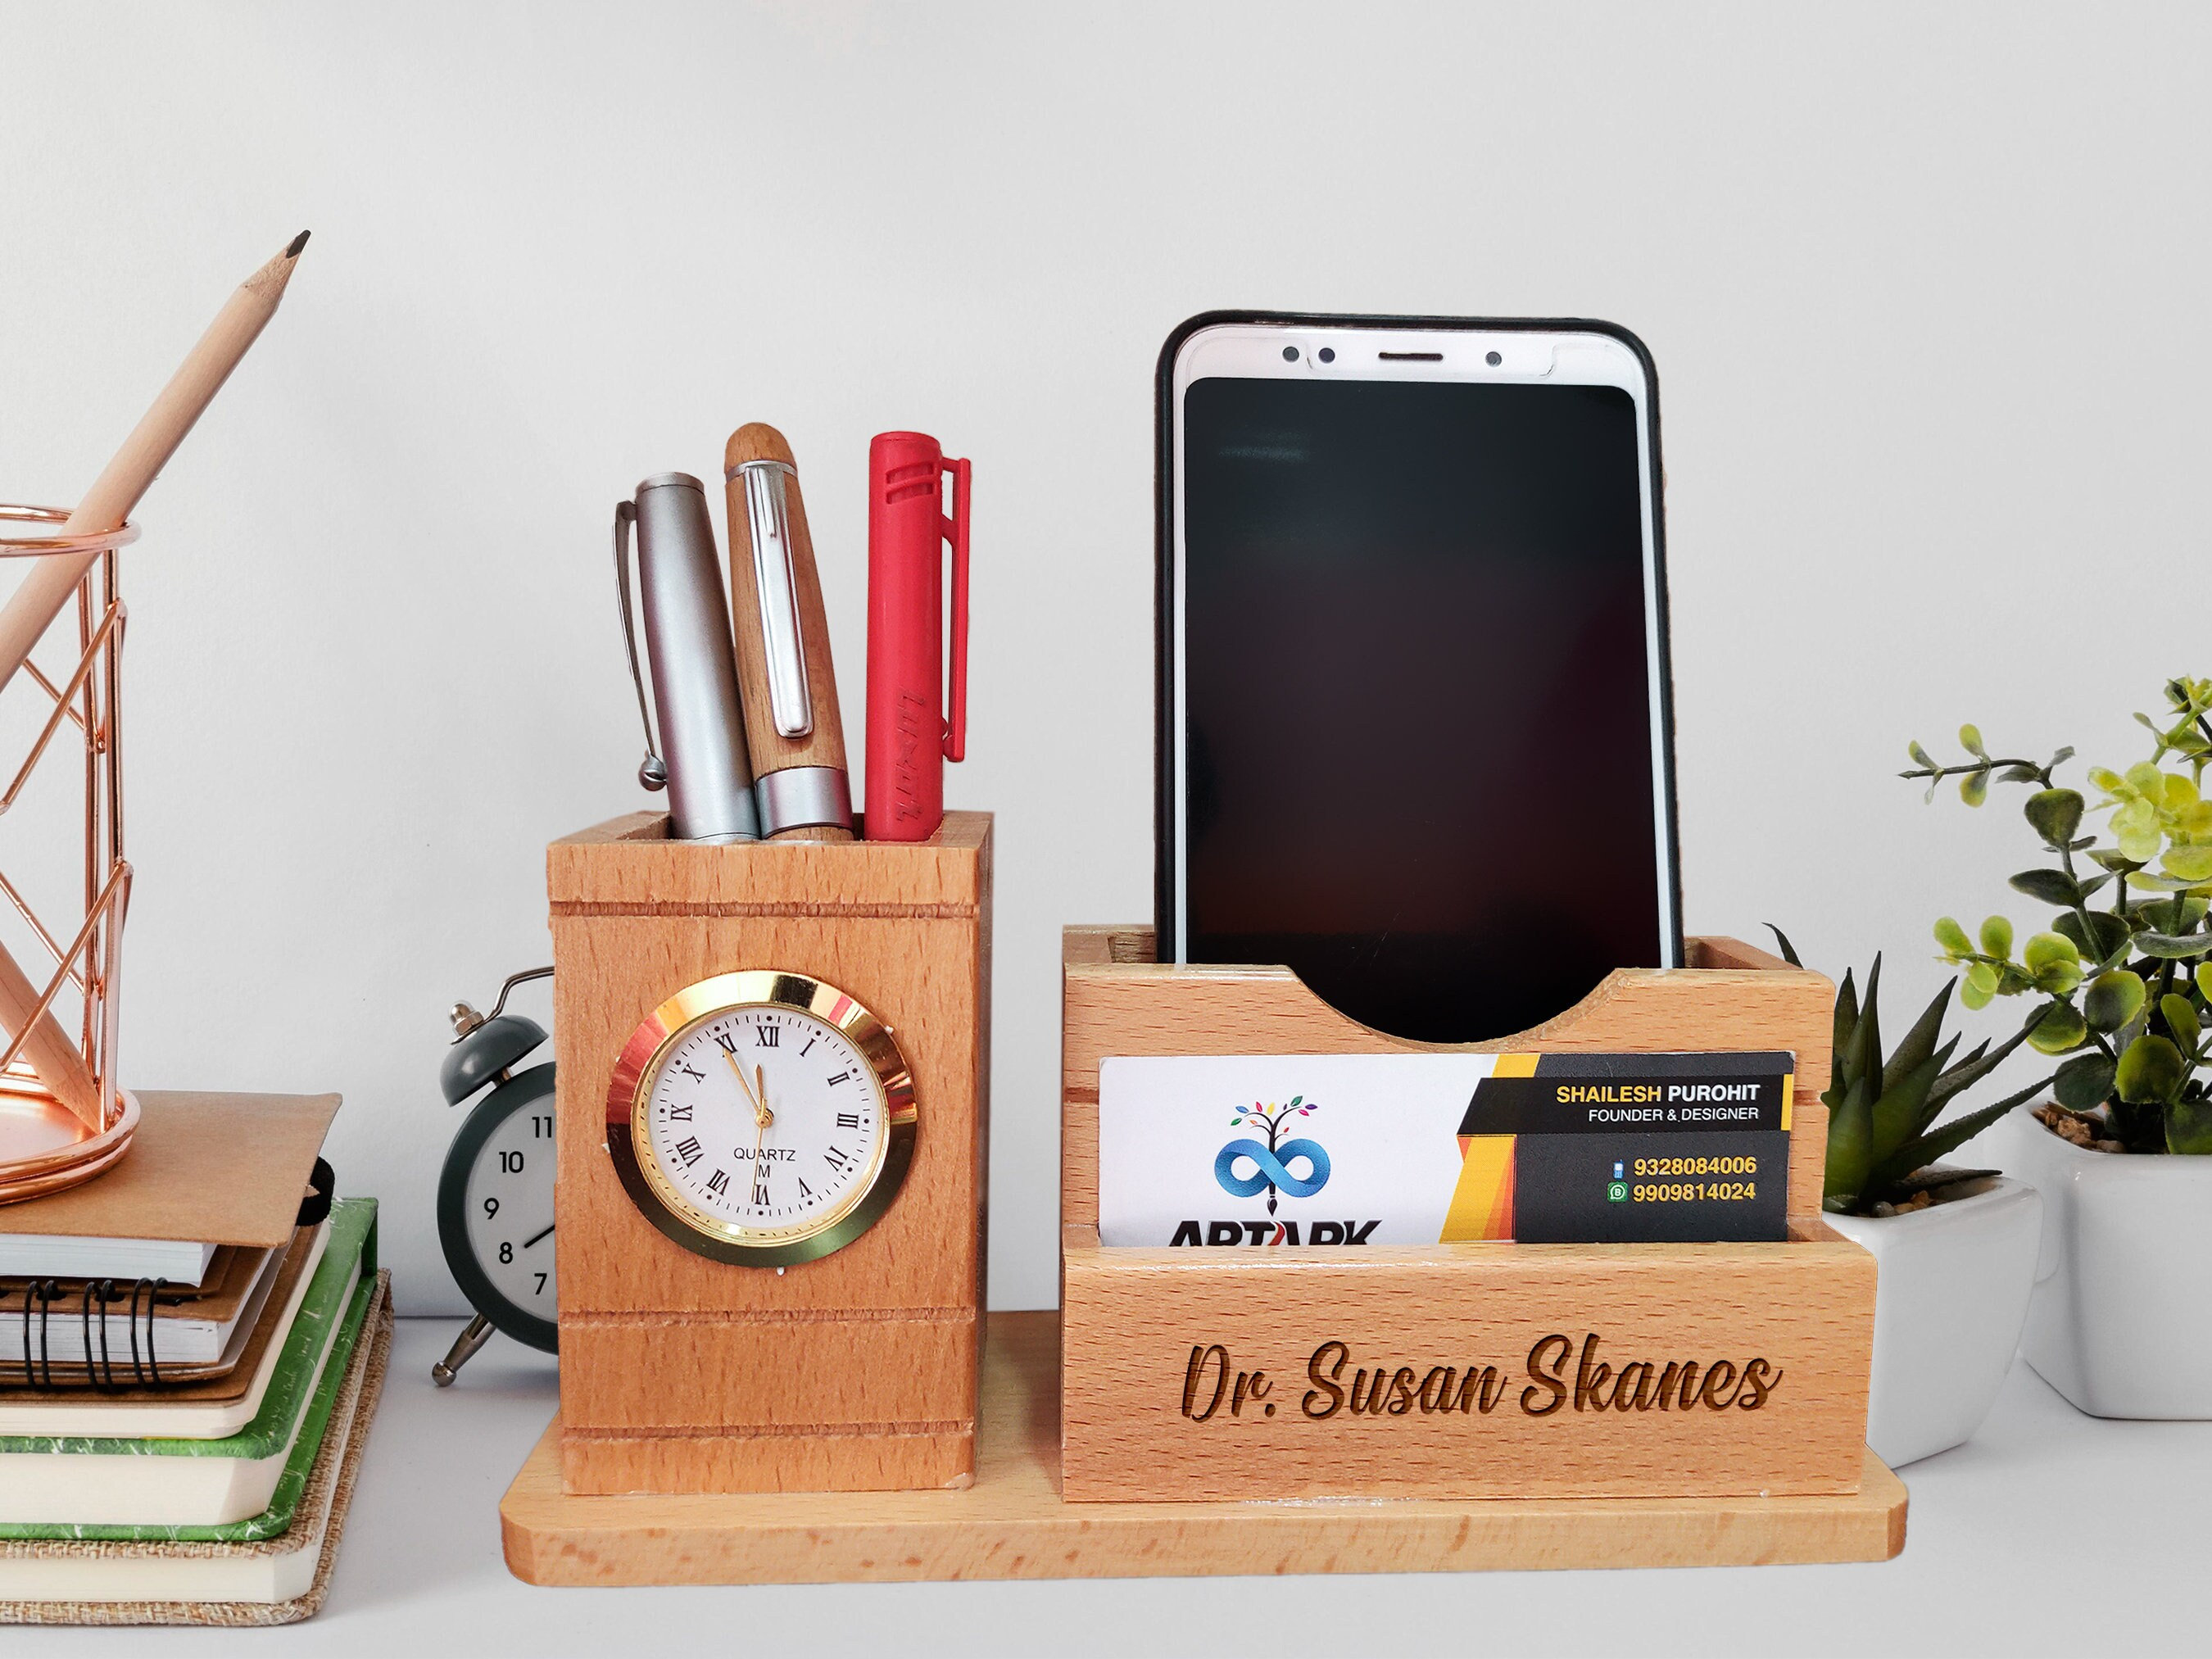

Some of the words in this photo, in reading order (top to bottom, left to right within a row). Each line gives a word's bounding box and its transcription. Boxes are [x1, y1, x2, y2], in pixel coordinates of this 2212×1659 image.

[714, 1032, 738, 1058] XI
[755, 1026, 781, 1047] XII
[682, 1063, 706, 1085] X
[827, 1071, 850, 1087] II
[1556, 1086, 1662, 1104] SHAILESH
[1667, 1084, 1761, 1102] PUROHIT
[670, 1104, 693, 1122] IX
[836, 1112, 859, 1129] III
[1588, 1109, 1663, 1122] FOUNDER
[1666, 1109, 1678, 1122] &
[1681, 1107, 1759, 1121] DESIGNER
[532, 1117, 552, 1138] 11
[499, 1151, 524, 1173] 10
[675, 1135, 705, 1168] VIII
[733, 1147, 796, 1162] QUARTZ
[823, 1145, 849, 1172] IV
[758, 1164, 771, 1178] M
[1634, 1156, 1757, 1176] 9328084006
[706, 1168, 731, 1196] VII
[798, 1176, 813, 1198] V
[1633, 1182, 1756, 1202] 9909814024
[755, 1184, 770, 1206] VI
[483, 1198, 500, 1220] 9
[498, 1241, 514, 1264] 8
[533, 1273, 547, 1295] 7
[1181, 1344, 1276, 1423] Dr.
[1301, 1339, 1508, 1421] Susan
[1518, 1331, 1784, 1417] Skanes
